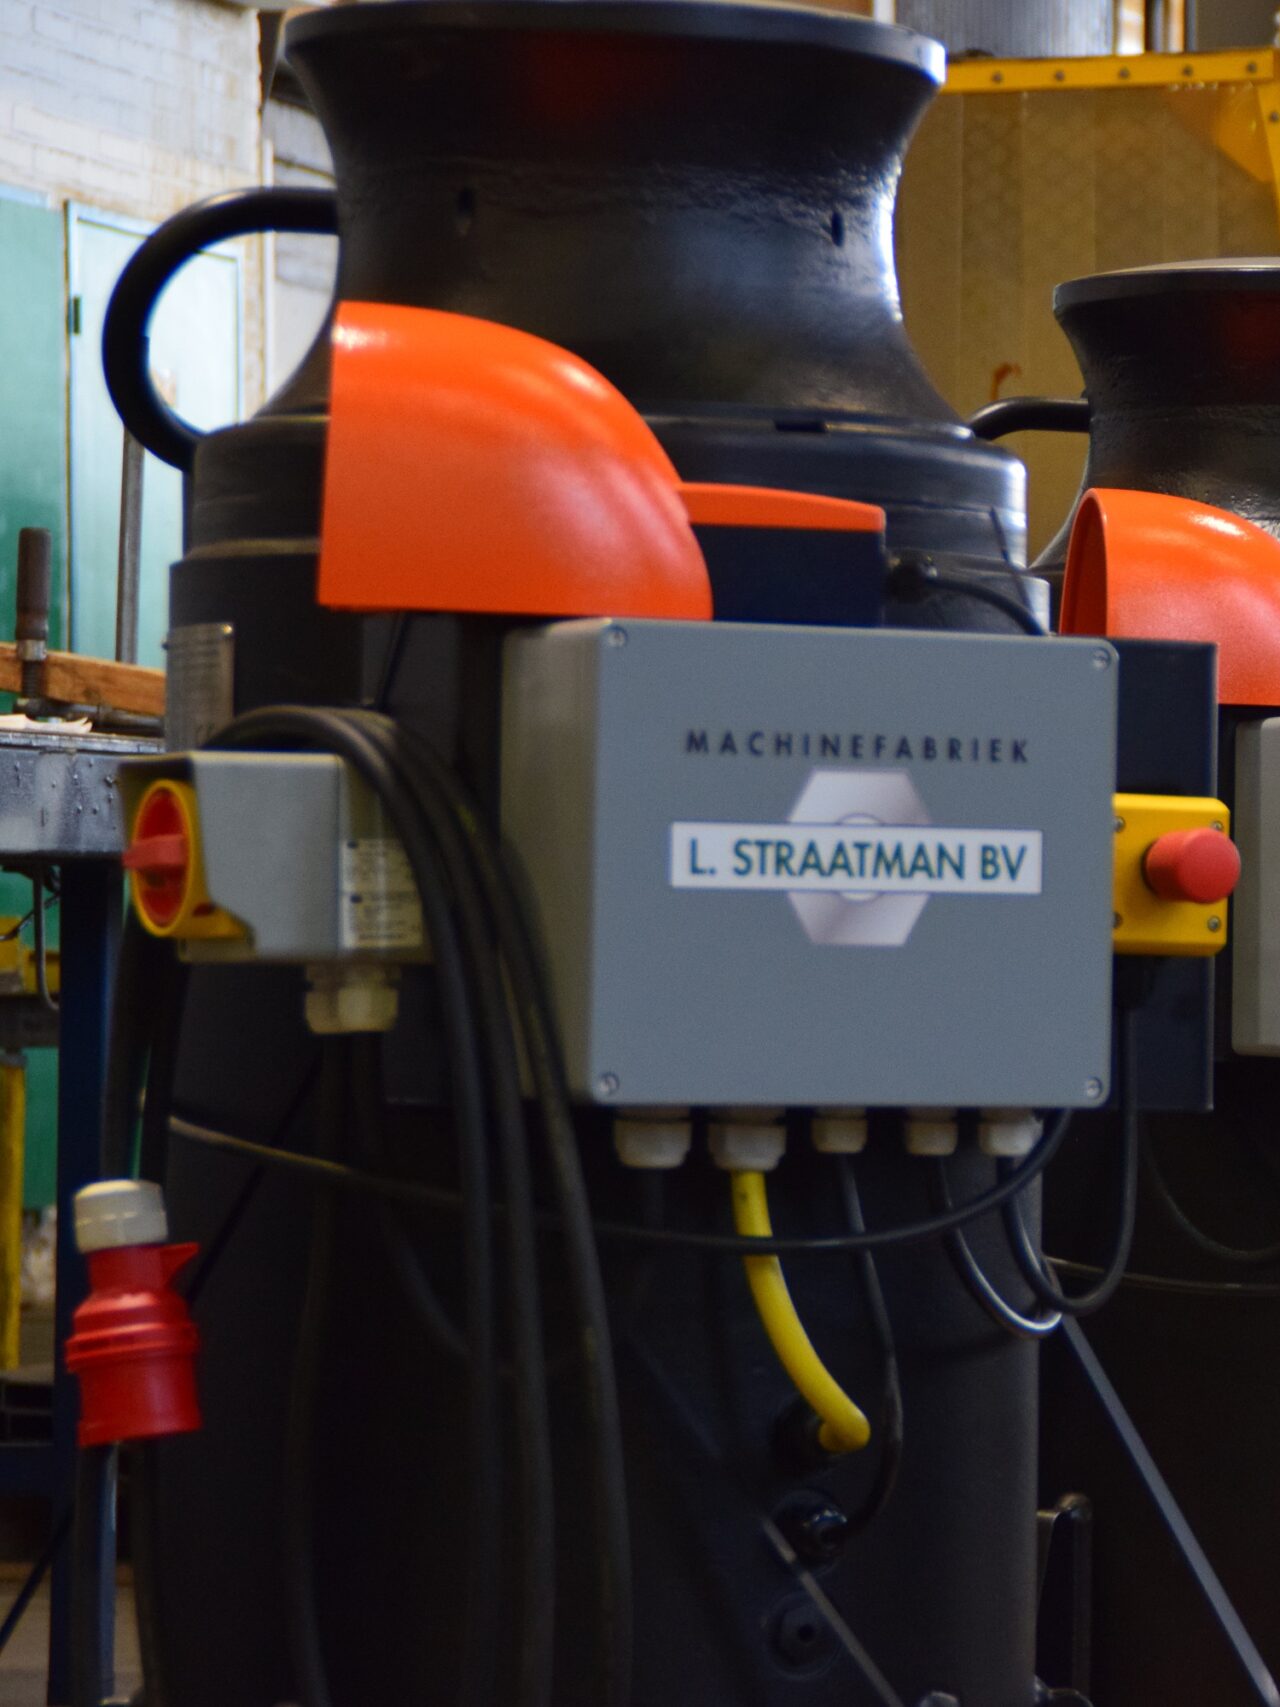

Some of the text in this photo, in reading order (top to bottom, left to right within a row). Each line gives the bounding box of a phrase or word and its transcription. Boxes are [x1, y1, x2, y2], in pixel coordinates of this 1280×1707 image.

[685, 729, 1029, 763] MACHINEFABRIEK
[689, 837, 1027, 881] L. STRAATMAN BV
